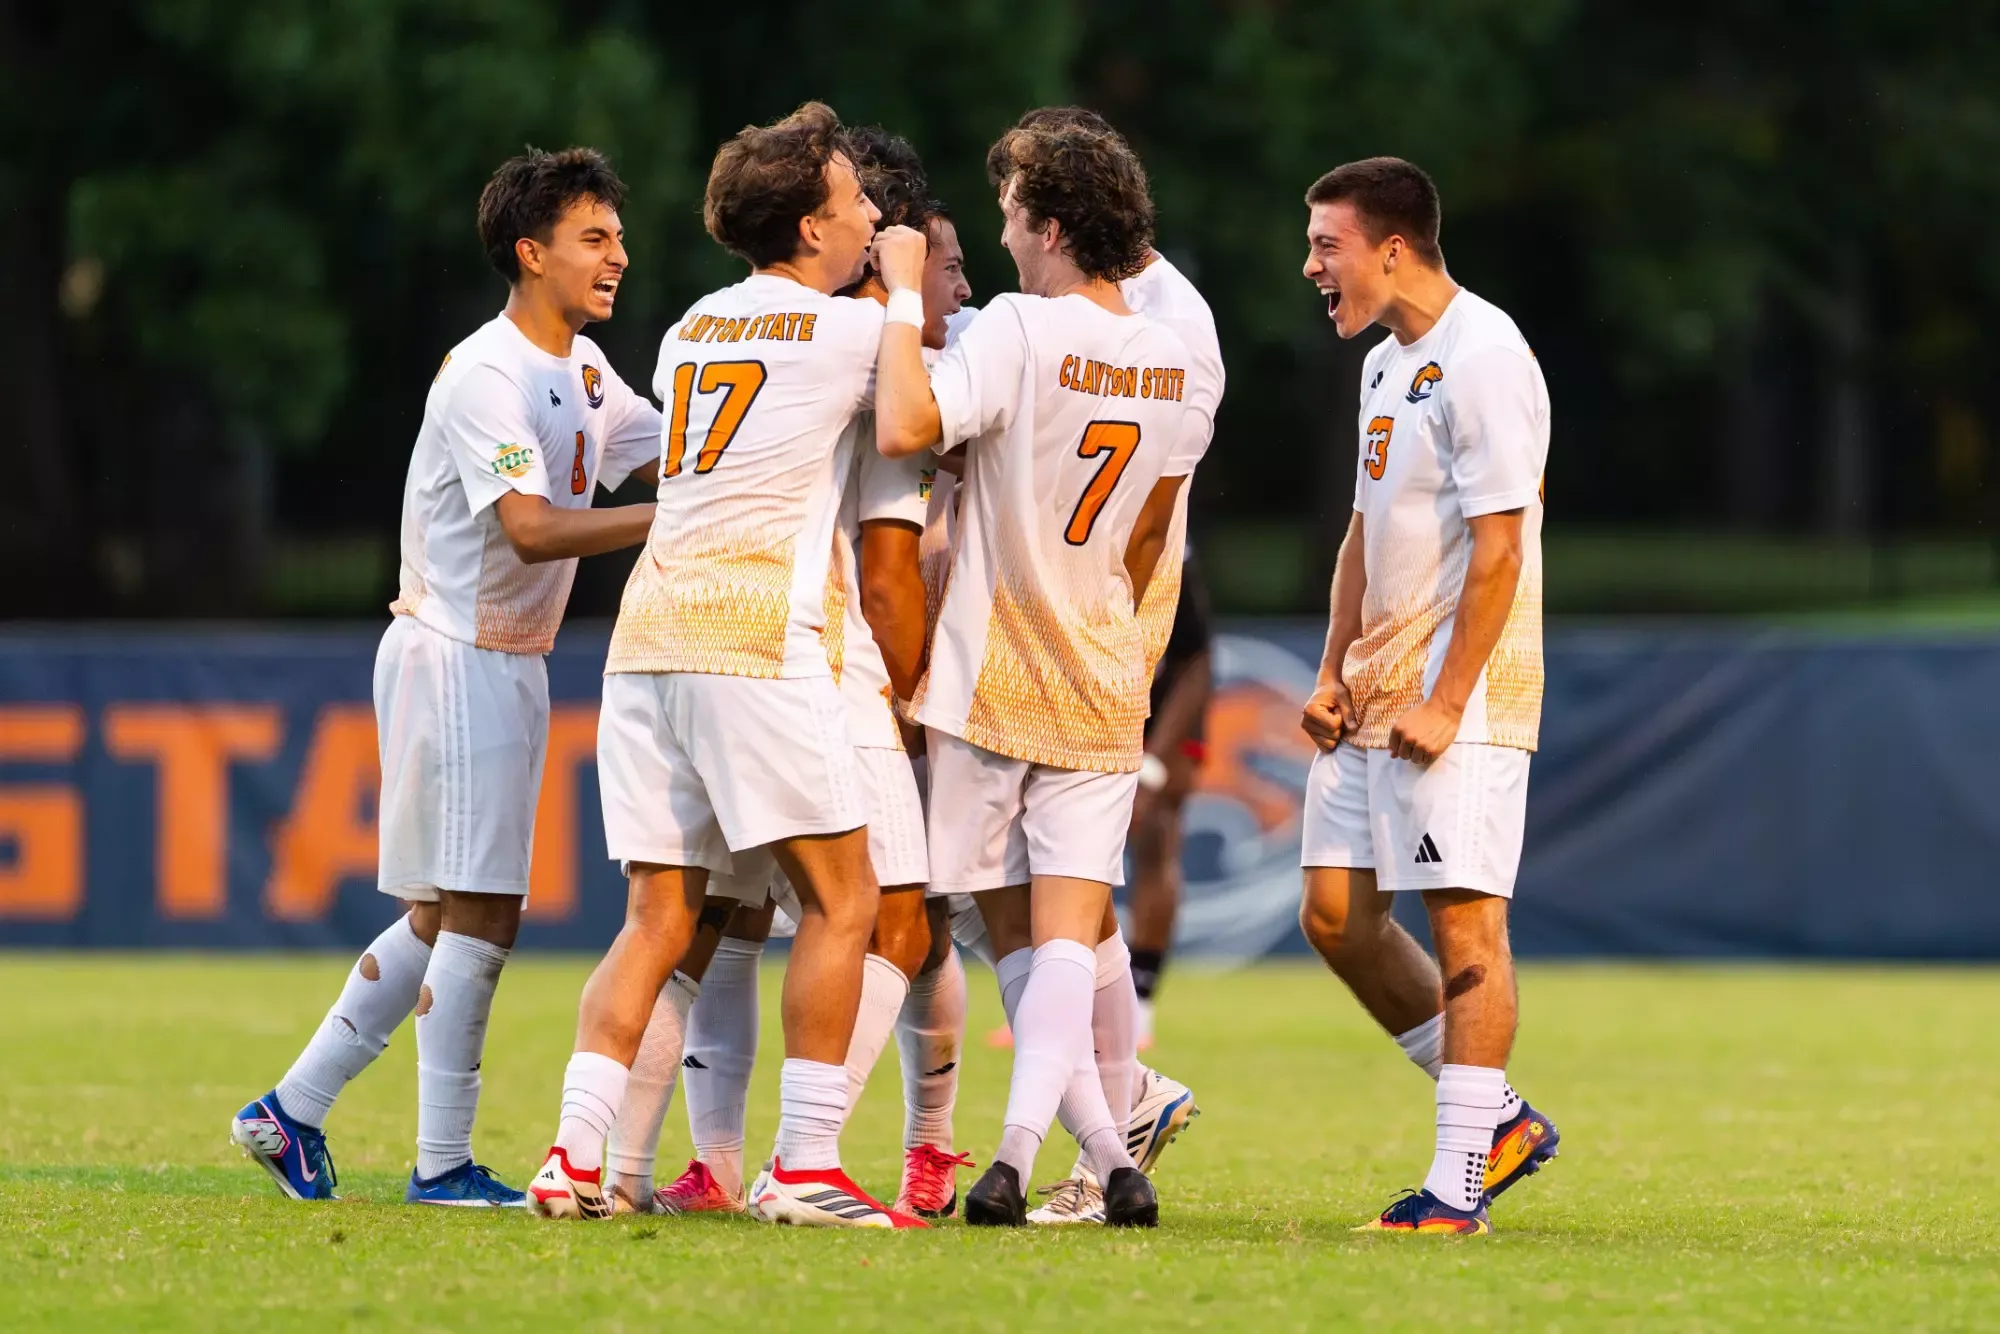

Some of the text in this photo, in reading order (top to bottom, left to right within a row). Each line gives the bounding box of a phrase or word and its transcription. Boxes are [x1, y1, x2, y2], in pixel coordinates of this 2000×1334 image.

[678, 313, 817, 343] AYTON STATE
[663, 359, 768, 478] 17
[1059, 354, 1185, 402] CLAYTON STATE
[1063, 420, 1141, 546] 7
